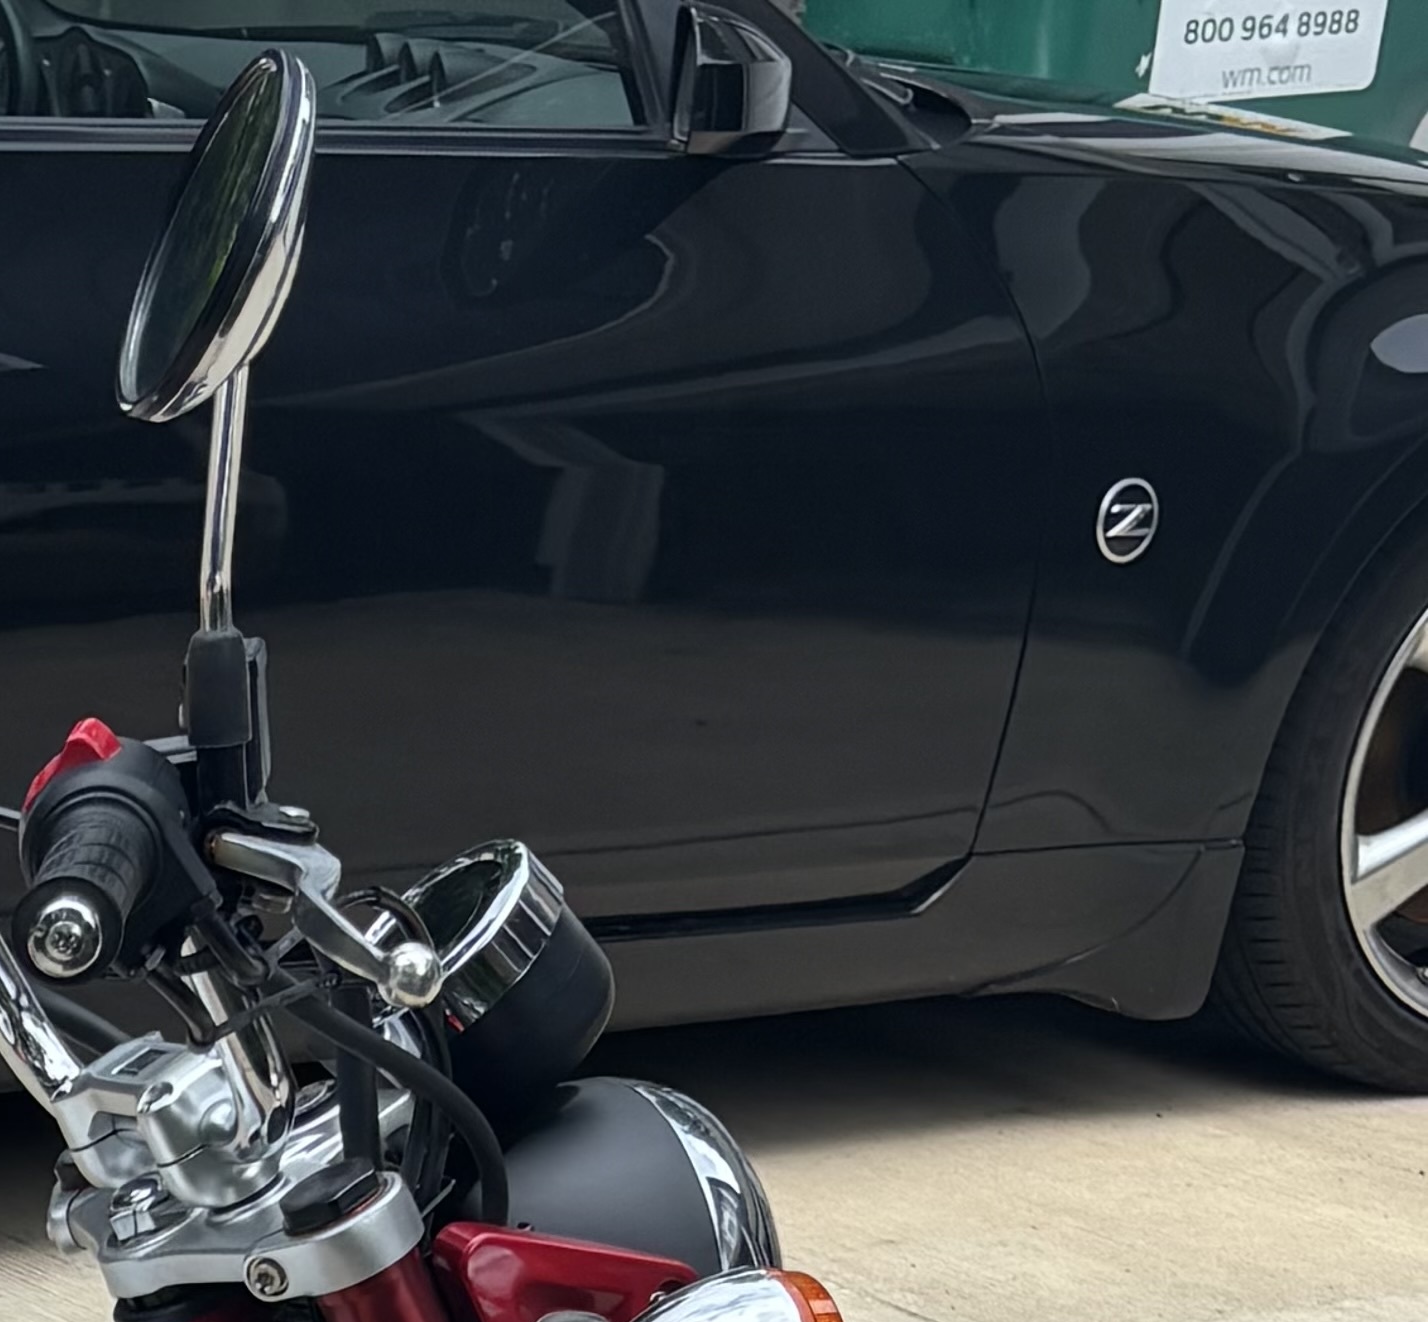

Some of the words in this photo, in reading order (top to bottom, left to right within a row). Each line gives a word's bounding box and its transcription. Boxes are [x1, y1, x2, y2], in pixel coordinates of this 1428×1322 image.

[1184, 17, 1234, 45] 800
[1240, 13, 1289, 41] 964
[1296, 9, 1360, 36] 8988
[1221, 63, 1312, 90] wm.com
